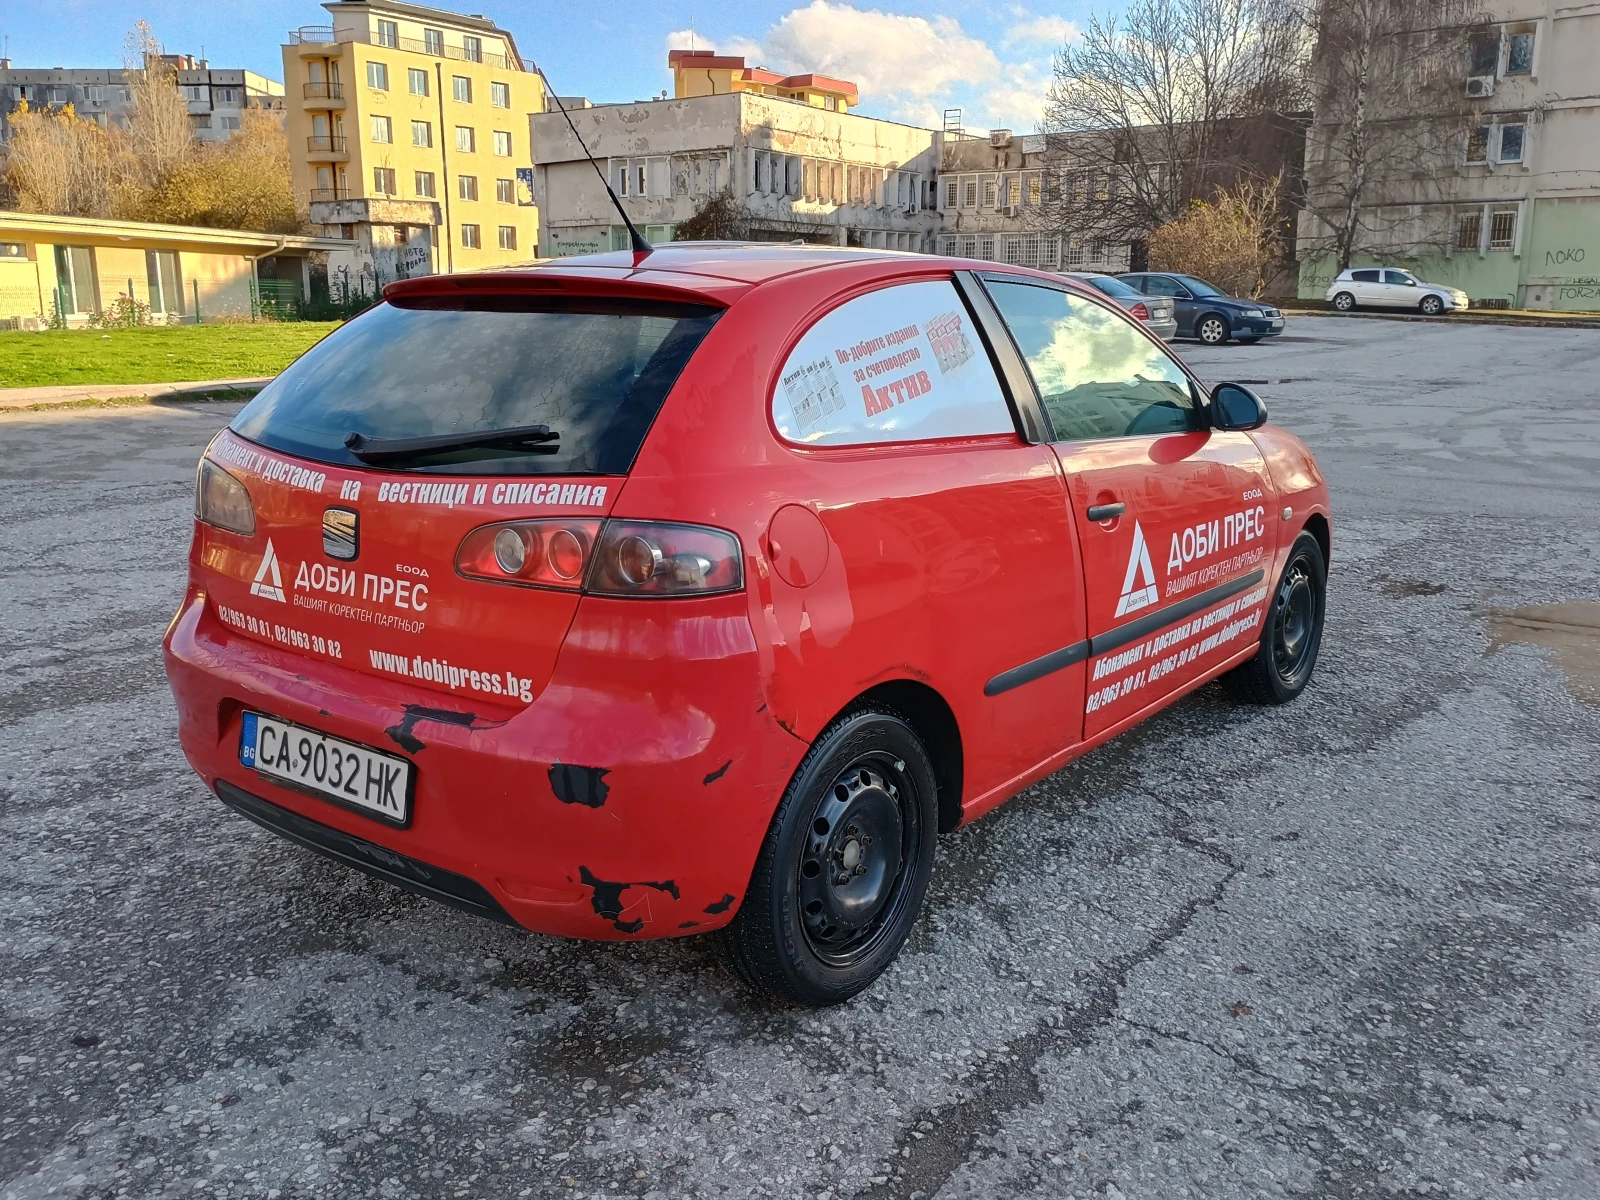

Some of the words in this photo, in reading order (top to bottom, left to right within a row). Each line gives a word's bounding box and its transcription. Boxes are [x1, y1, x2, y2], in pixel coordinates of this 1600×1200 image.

[834, 336, 886, 365] По-добрите
[885, 323, 920, 347] издания
[853, 366, 867, 383] за
[868, 346, 921, 379] счетоводство
[860, 370, 932, 417] Актив
[254, 454, 266, 474] и
[262, 458, 326, 493] доставка
[340, 479, 362, 501] на
[377, 481, 470, 509] вестници
[472, 483, 492, 505] и
[492, 483, 607, 507] списания
[1243, 488, 1263, 501] ЕООД
[1167, 520, 1219, 576] ДОБИ
[1224, 505, 1265, 549] ПРЕС
[294, 560, 356, 596] ДОБИ
[362, 573, 429, 612] ПРЕС
[396, 564, 430, 578] ЕООД
[1165, 570, 1199, 598] ВАШИЯТ
[1198, 559, 1231, 583] КОРЕКТЕН
[1231, 546, 1264, 571] ПАРТНЬОР
[218, 604, 246, 629] 02/963
[246, 615, 258, 634] 30
[260, 619, 274, 641] 81,
[274, 624, 310, 650] 02/963
[311, 635, 325, 654] 30
[328, 639, 342, 659] 82
[293, 594, 328, 613] ВАШИЯТ
[329, 602, 372, 623] КОРЕКТЕН
[374, 613, 425, 634] ПАРТНЬОР
[1092, 643, 1145, 681] Абонамент
[1144, 641, 1152, 657] и
[1151, 623, 1191, 658] доставка
[1191, 618, 1202, 636] на
[1202, 602, 1235, 631] вестници
[369, 649, 534, 703] www.dobipress.bg
[1086, 680, 1119, 714] 02/963
[1120, 676, 1132, 697] 30
[1133, 669, 1146, 690] 81,
[1148, 658, 1176, 683] 02/963
[1177, 649, 1188, 667] 30
[1188, 645, 1198, 663] 82
[244, 745, 255, 760] BG
